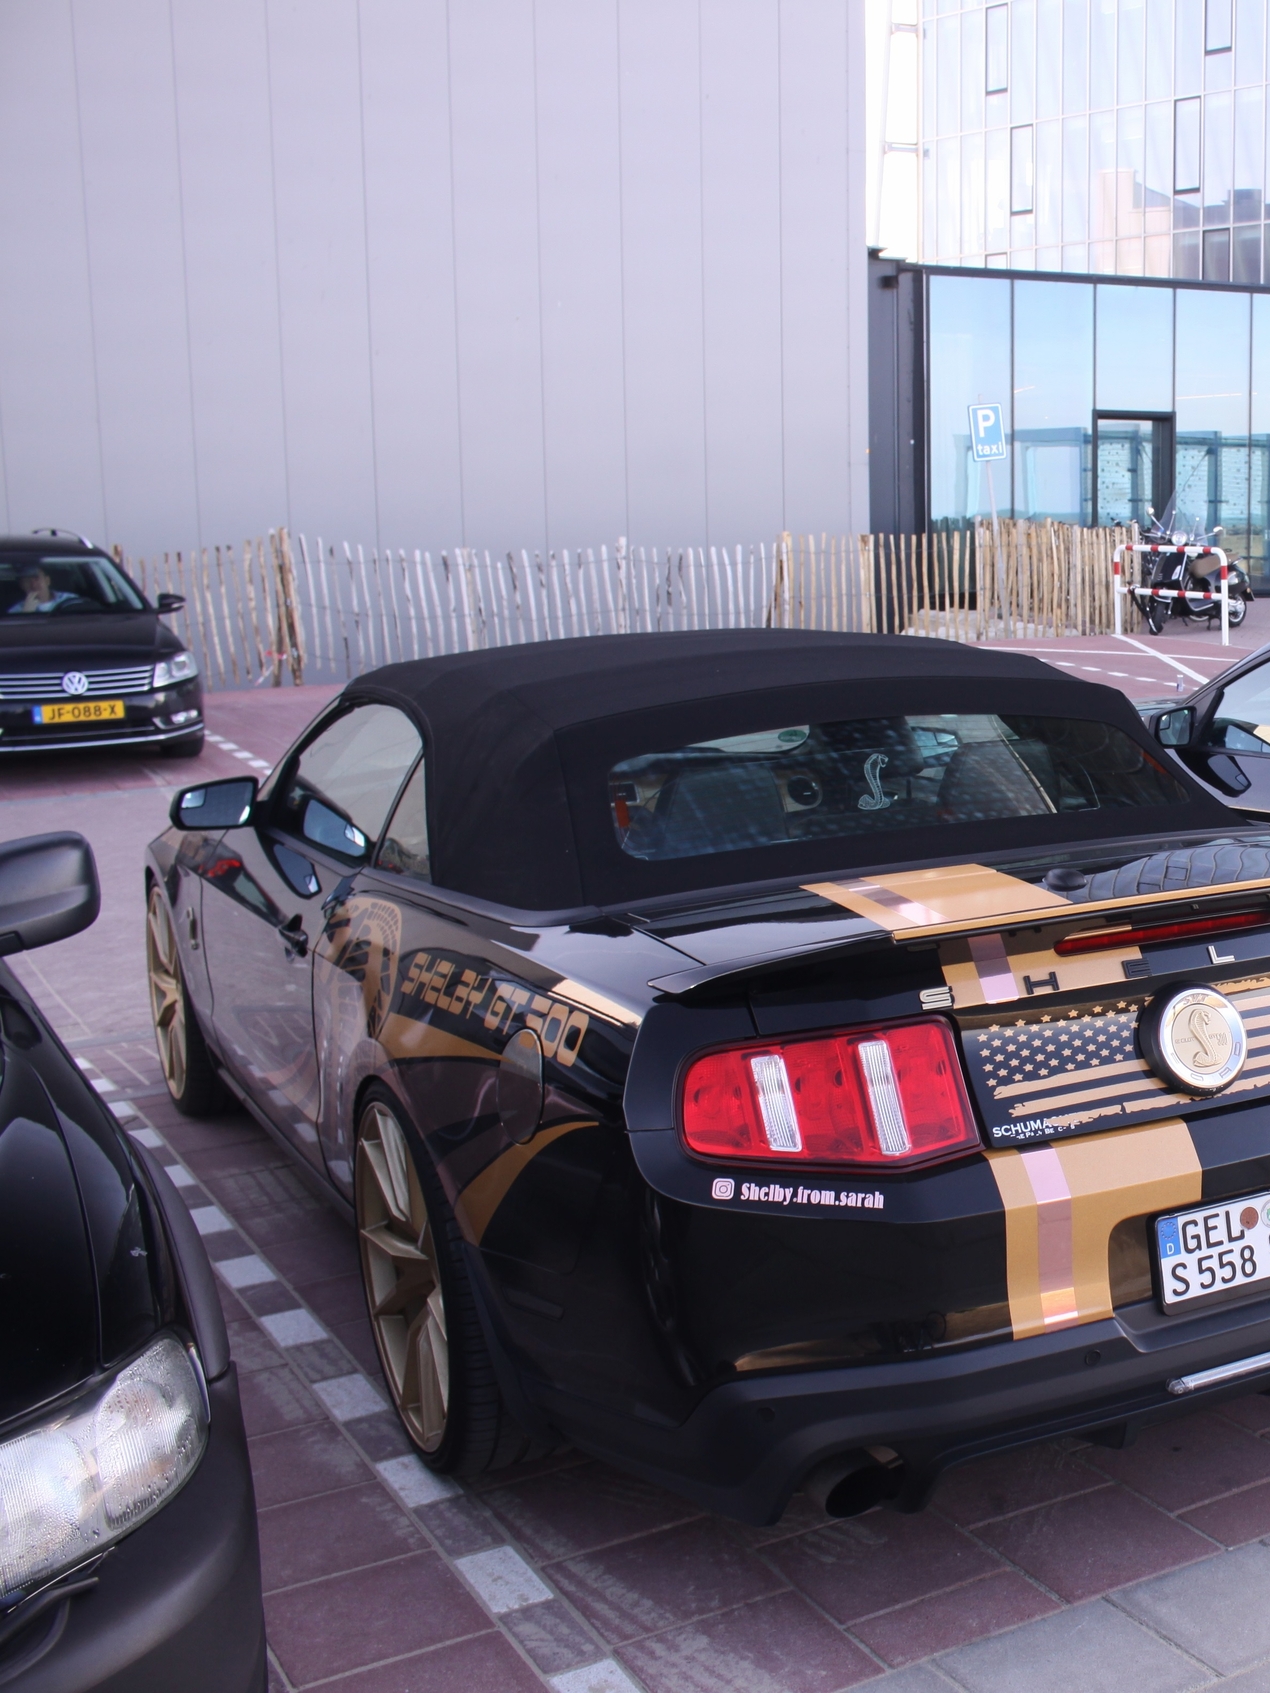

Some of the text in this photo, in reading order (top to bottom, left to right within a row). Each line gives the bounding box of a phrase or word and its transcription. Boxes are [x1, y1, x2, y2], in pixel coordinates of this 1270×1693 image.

[977, 409, 995, 438] P
[977, 441, 1003, 455] taxi
[48, 703, 117, 721] JF-088-X
[401, 952, 492, 1020] SHELBY
[741, 1182, 885, 1209] Shelby.from.sarah
[1181, 1210, 1246, 1254] GEL
[1166, 1243, 1175, 1255] D
[1171, 1244, 1257, 1297] S 558
